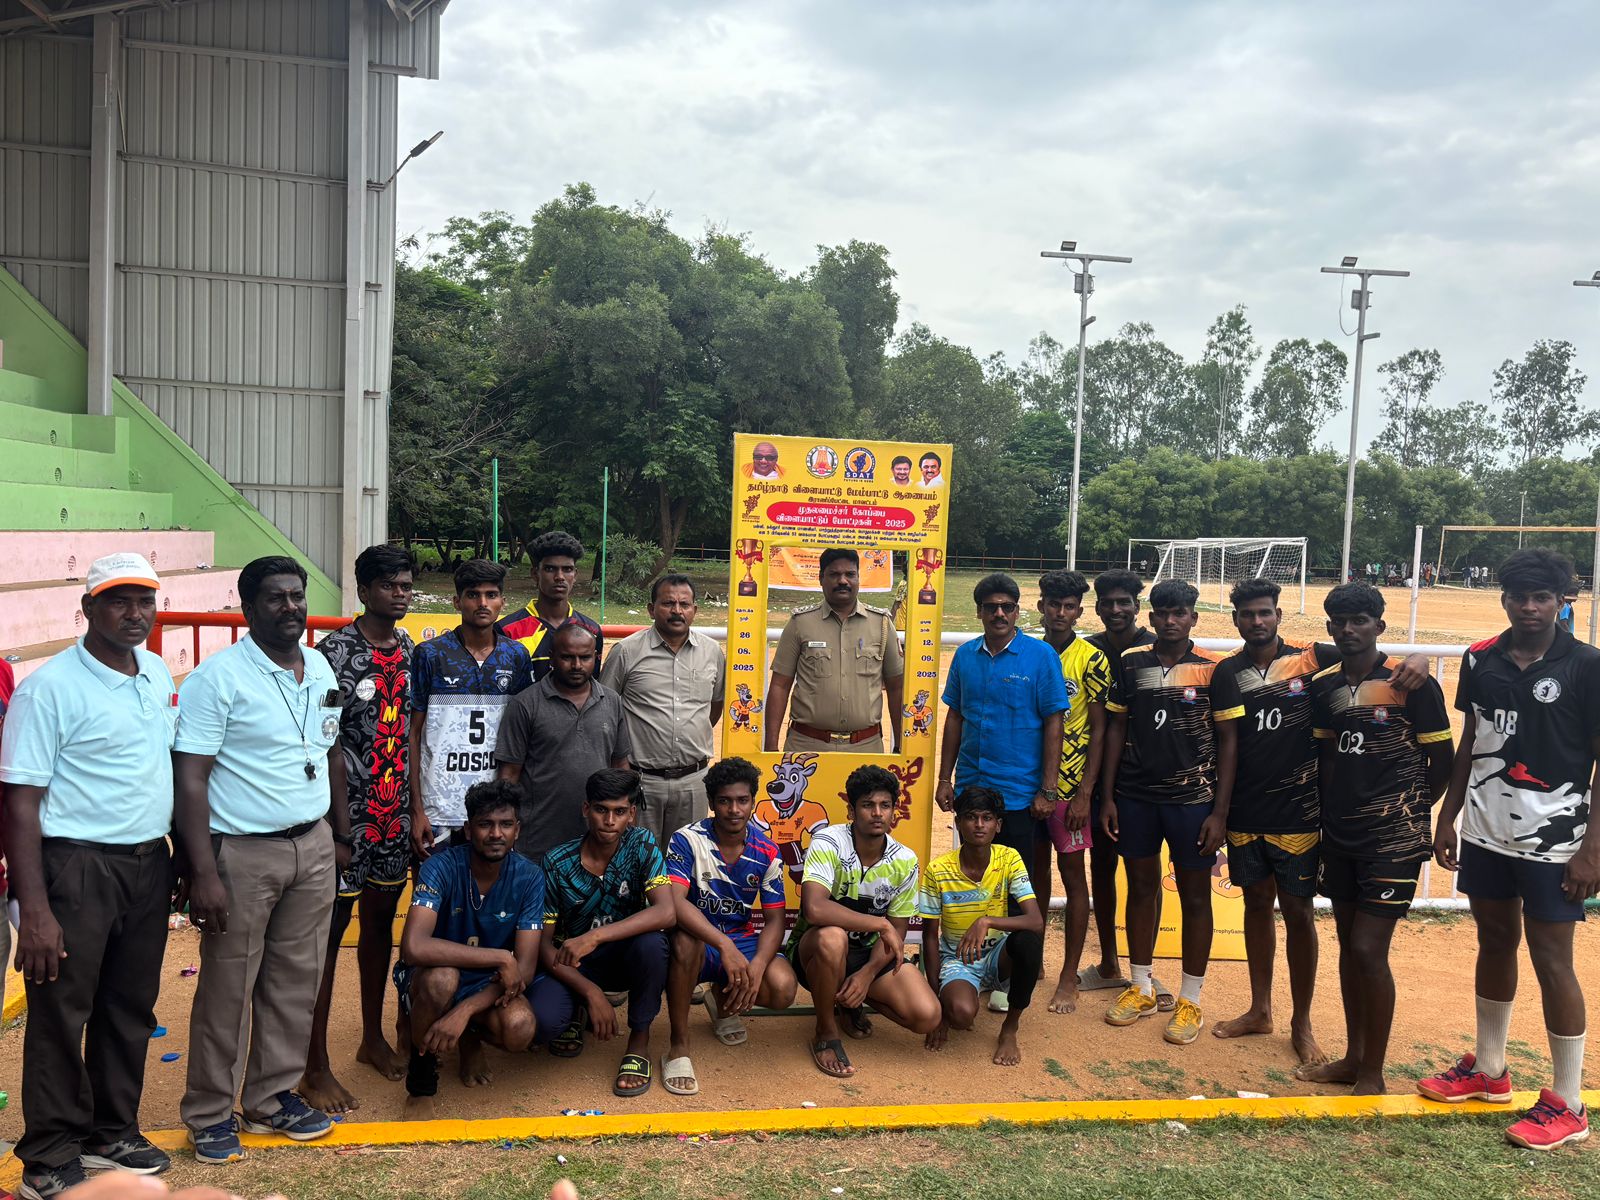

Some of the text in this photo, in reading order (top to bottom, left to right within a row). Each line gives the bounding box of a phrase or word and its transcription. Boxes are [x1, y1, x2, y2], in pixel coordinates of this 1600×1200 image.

[746, 482, 938, 500] தமிழ்நாடு விளையாட்டு மேம்பாட்டு ஆணையம்
[776, 513, 828, 524] விளையாட்டுப்
[832, 516, 872, 527] போட்டிகள்
[885, 519, 906, 528] 2025
[798, 506, 886, 517] முதலமைச்சர் கோப்பை
[469, 710, 485, 745] 5
[1154, 708, 1166, 730] 9
[1255, 707, 1282, 732] 10
[1494, 708, 1518, 735] 08
[1338, 730, 1365, 755] 02
[446, 752, 498, 772] COSCO
